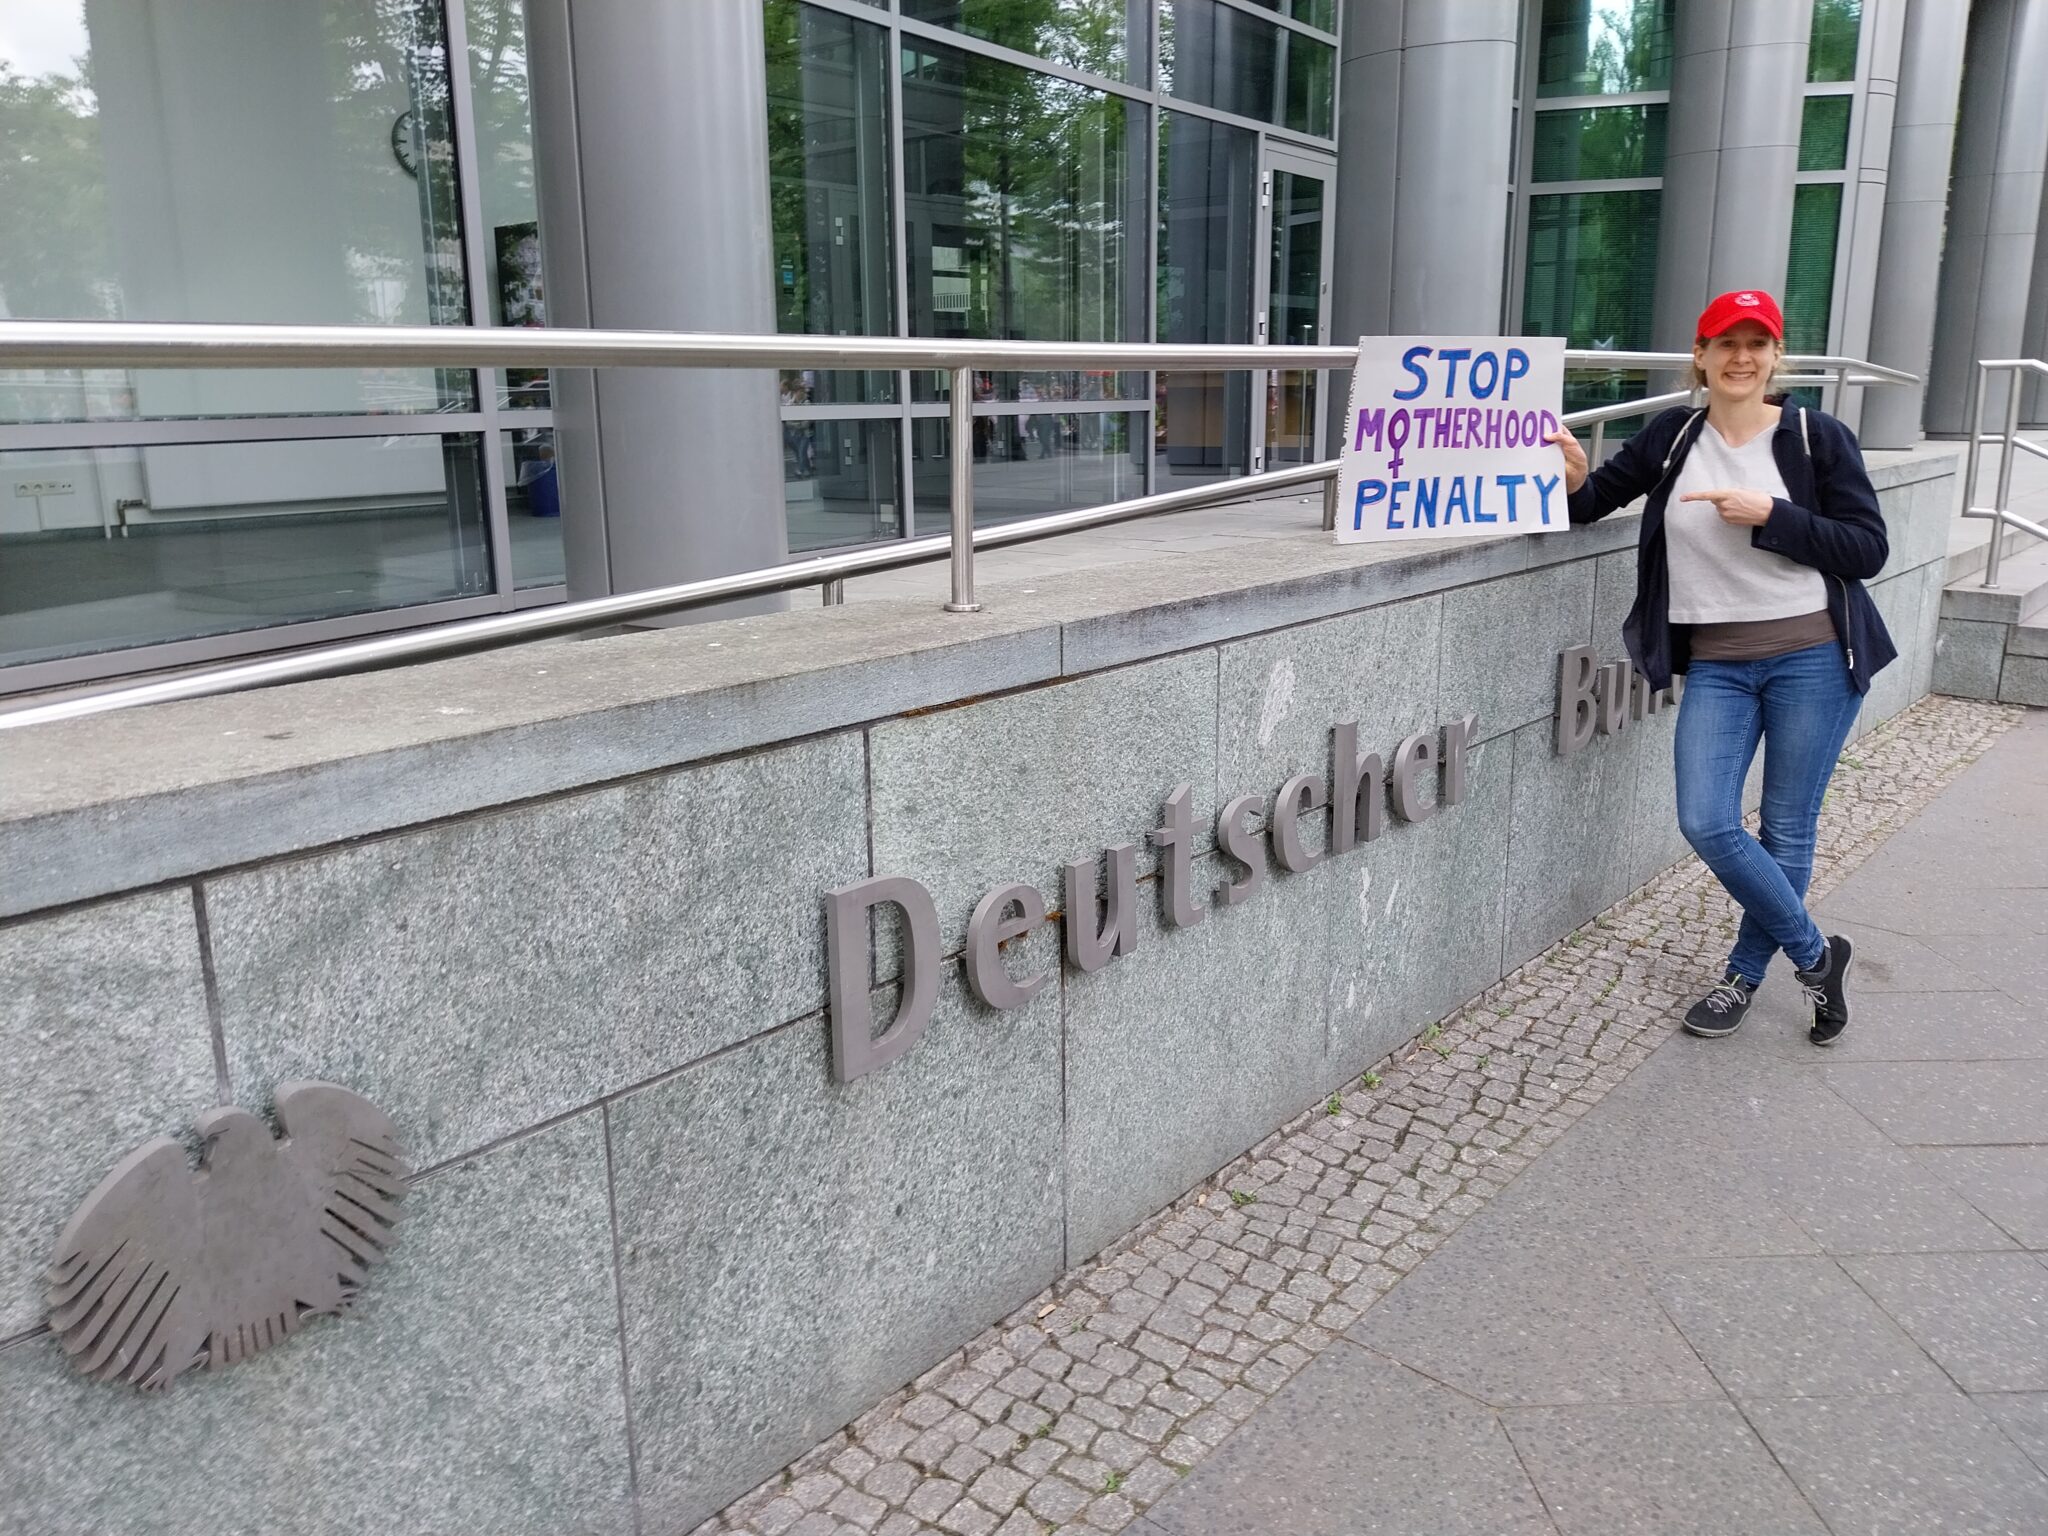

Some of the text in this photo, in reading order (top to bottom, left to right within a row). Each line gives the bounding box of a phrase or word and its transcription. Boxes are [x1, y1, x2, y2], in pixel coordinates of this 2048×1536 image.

[1393, 346, 1530, 401] STOP
[1354, 407, 1558, 454] MOTHERHOOD
[1353, 474, 1560, 530] PENALTY
[826, 713, 1478, 1083] Deutscher
